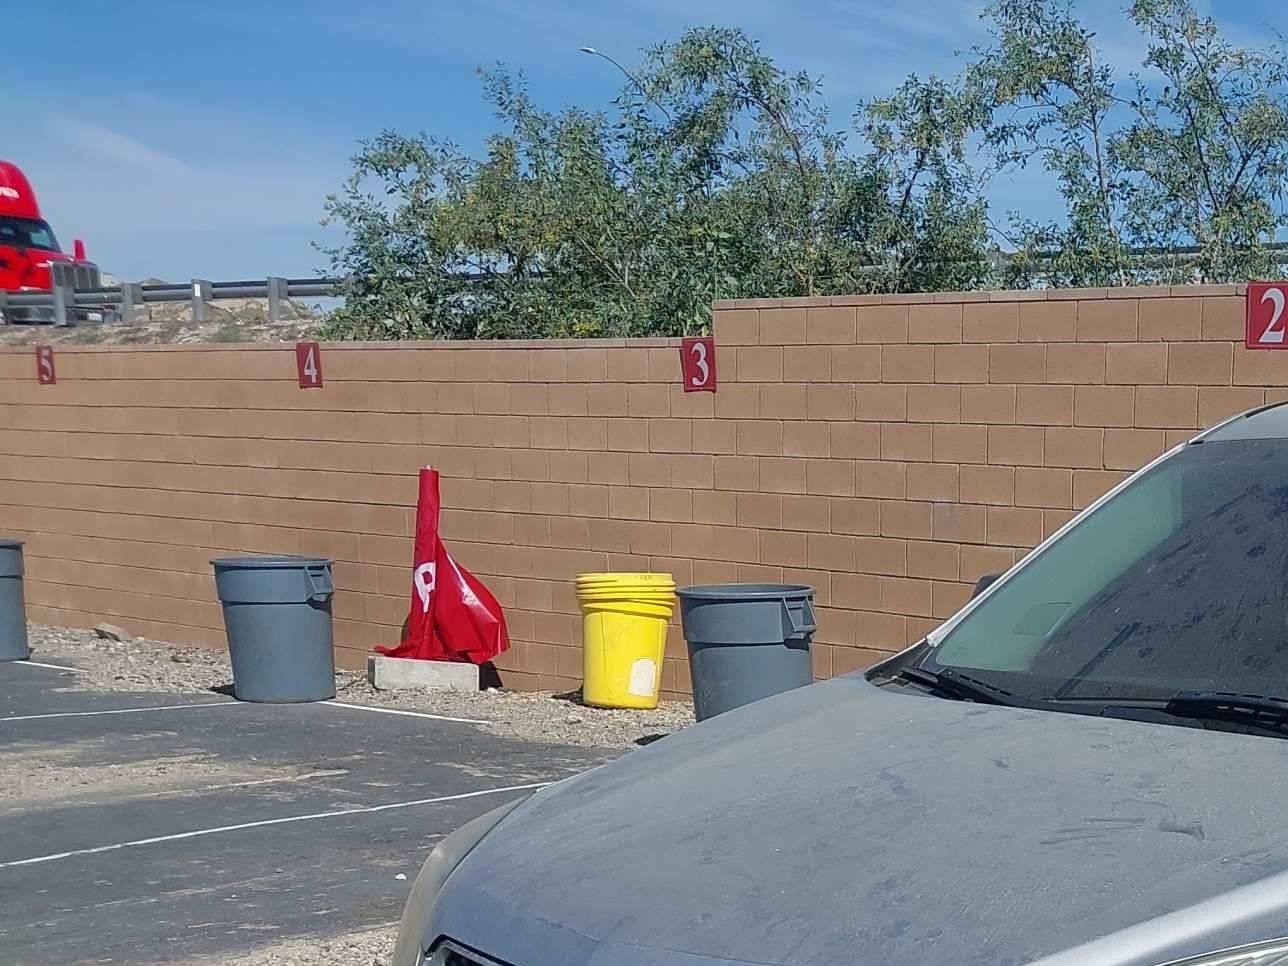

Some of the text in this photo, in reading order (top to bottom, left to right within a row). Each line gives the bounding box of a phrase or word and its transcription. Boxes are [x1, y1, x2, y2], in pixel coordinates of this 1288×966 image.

[1258, 287, 1286, 343] 2
[41, 349, 53, 381] 5
[303, 346, 318, 384] 4
[690, 342, 710, 386] 3
